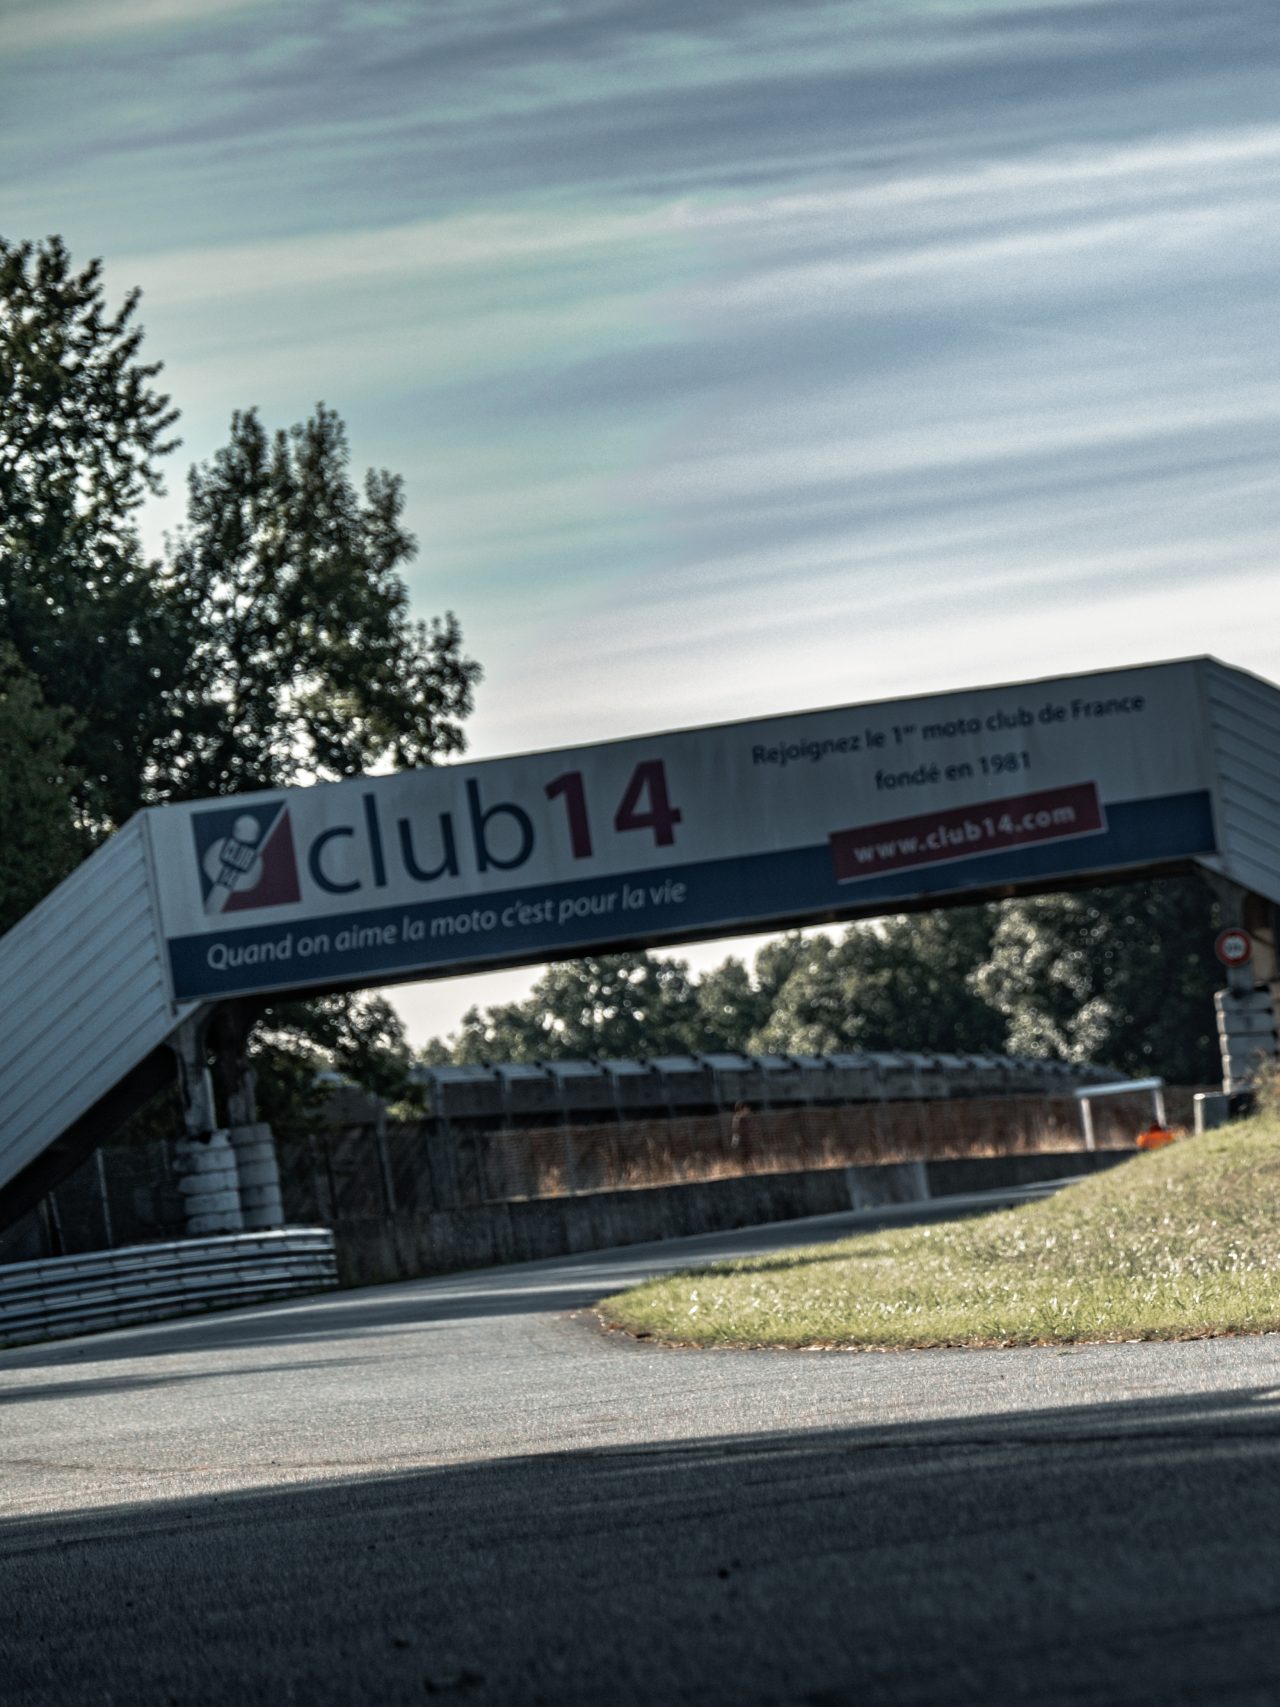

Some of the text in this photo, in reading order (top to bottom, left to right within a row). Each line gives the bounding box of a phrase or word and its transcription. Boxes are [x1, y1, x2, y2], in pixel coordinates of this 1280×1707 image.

[752, 735, 861, 766] Rejoignez
[865, 728, 886, 749] le
[922, 716, 982, 740] moto
[986, 706, 1034, 731] club
[1038, 702, 1067, 725] de
[1070, 695, 1145, 721] France
[875, 751, 1031, 791] fondé en 1981
[853, 805, 1076, 864] www.club14.com
[207, 878, 687, 970] Quand on aime la moto c'est pour la vie
